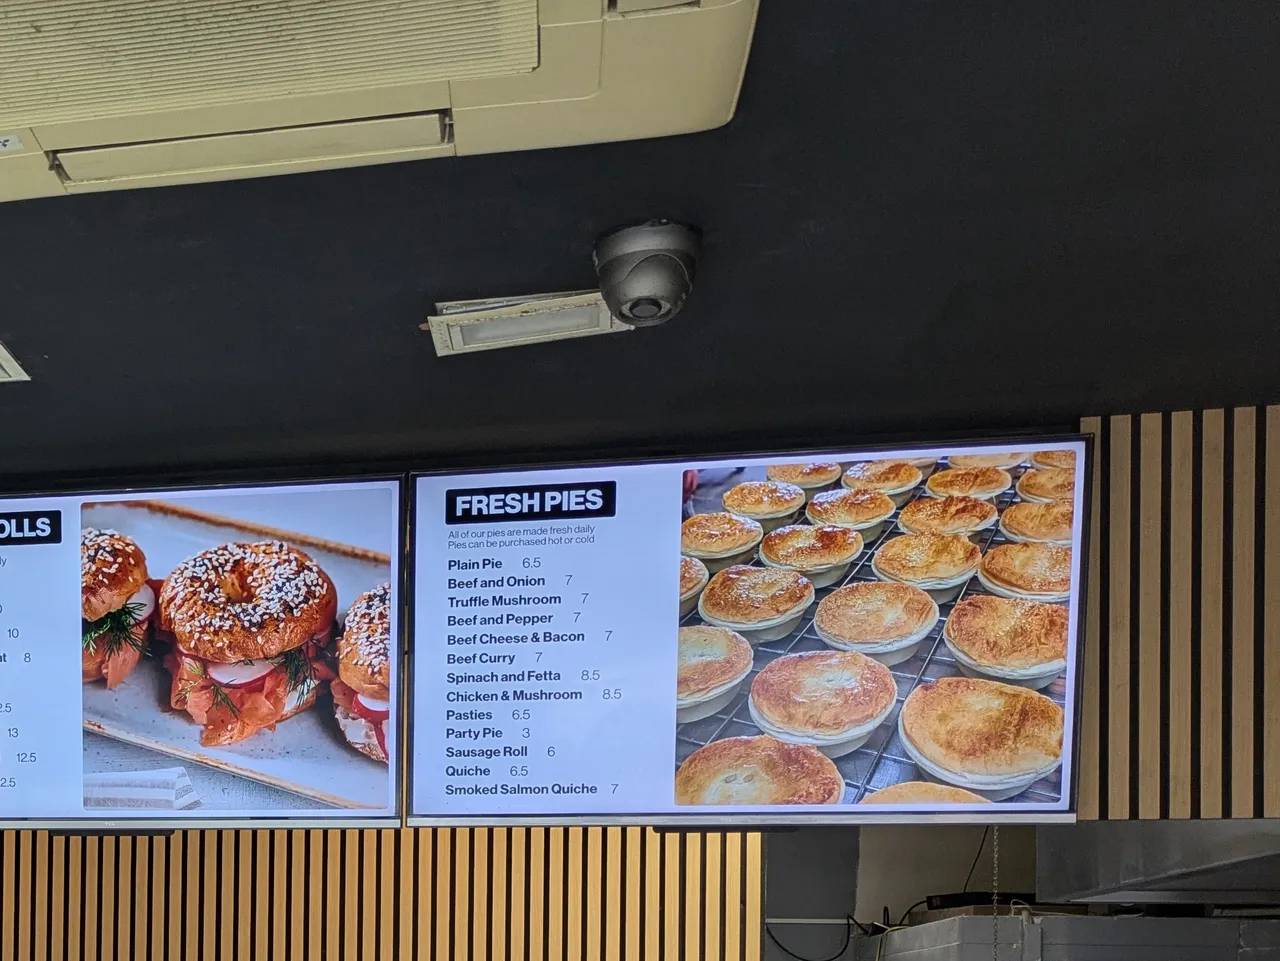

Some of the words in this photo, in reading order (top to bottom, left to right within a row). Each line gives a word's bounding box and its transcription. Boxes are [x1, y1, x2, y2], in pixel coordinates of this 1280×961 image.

[456, 492, 540, 516] FRESH
[545, 489, 603, 511] PIES
[448, 560, 479, 570] Plain
[483, 558, 502, 569] Pie
[523, 558, 540, 568] 6.5
[448, 578, 478, 589] Beef
[480, 577, 504, 588] and
[507, 576, 545, 586] Onion
[566, 575, 572, 585] 7
[448, 596, 489, 607] Truffle
[492, 595, 561, 606] Mushroom
[582, 593, 588, 603] 7
[8, 629, 18, 638] 10
[448, 654, 476, 664] Beef
[479, 653, 515, 664] Curry
[536, 652, 542, 662] 7
[447, 672, 498, 685] Spinach
[501, 671, 524, 682] and
[528, 671, 560, 681] Fetta
[582, 670, 600, 680] 8.5
[447, 710, 492, 720] Pasties
[512, 710, 530, 720] 6.5
[446, 728, 480, 740] Party
[483, 728, 502, 738] Pie
[523, 728, 530, 738] 3
[446, 766, 490, 776] Quiche
[510, 766, 528, 776] 6.5
